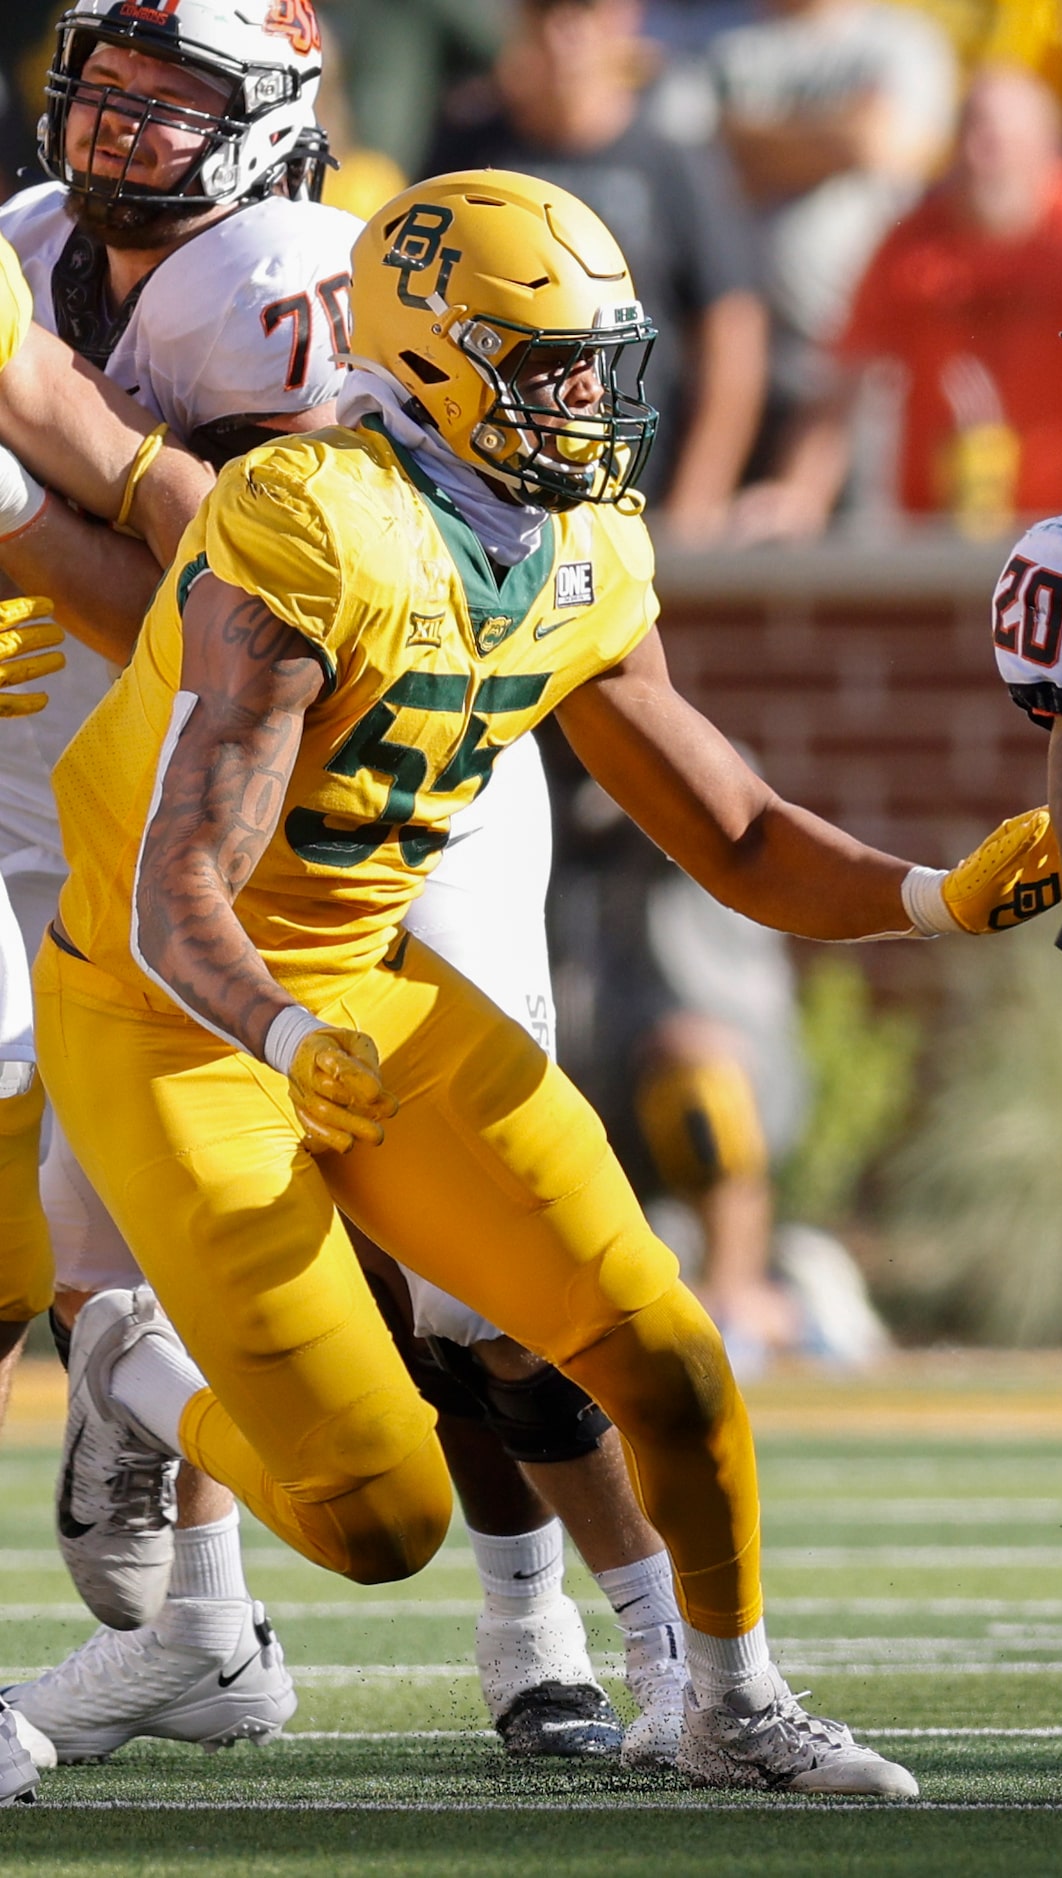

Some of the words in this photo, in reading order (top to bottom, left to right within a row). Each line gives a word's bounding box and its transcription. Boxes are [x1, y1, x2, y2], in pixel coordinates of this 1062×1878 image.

[558, 564, 591, 597] ONE
[405, 611, 446, 649] XII
[284, 670, 554, 869] 55
